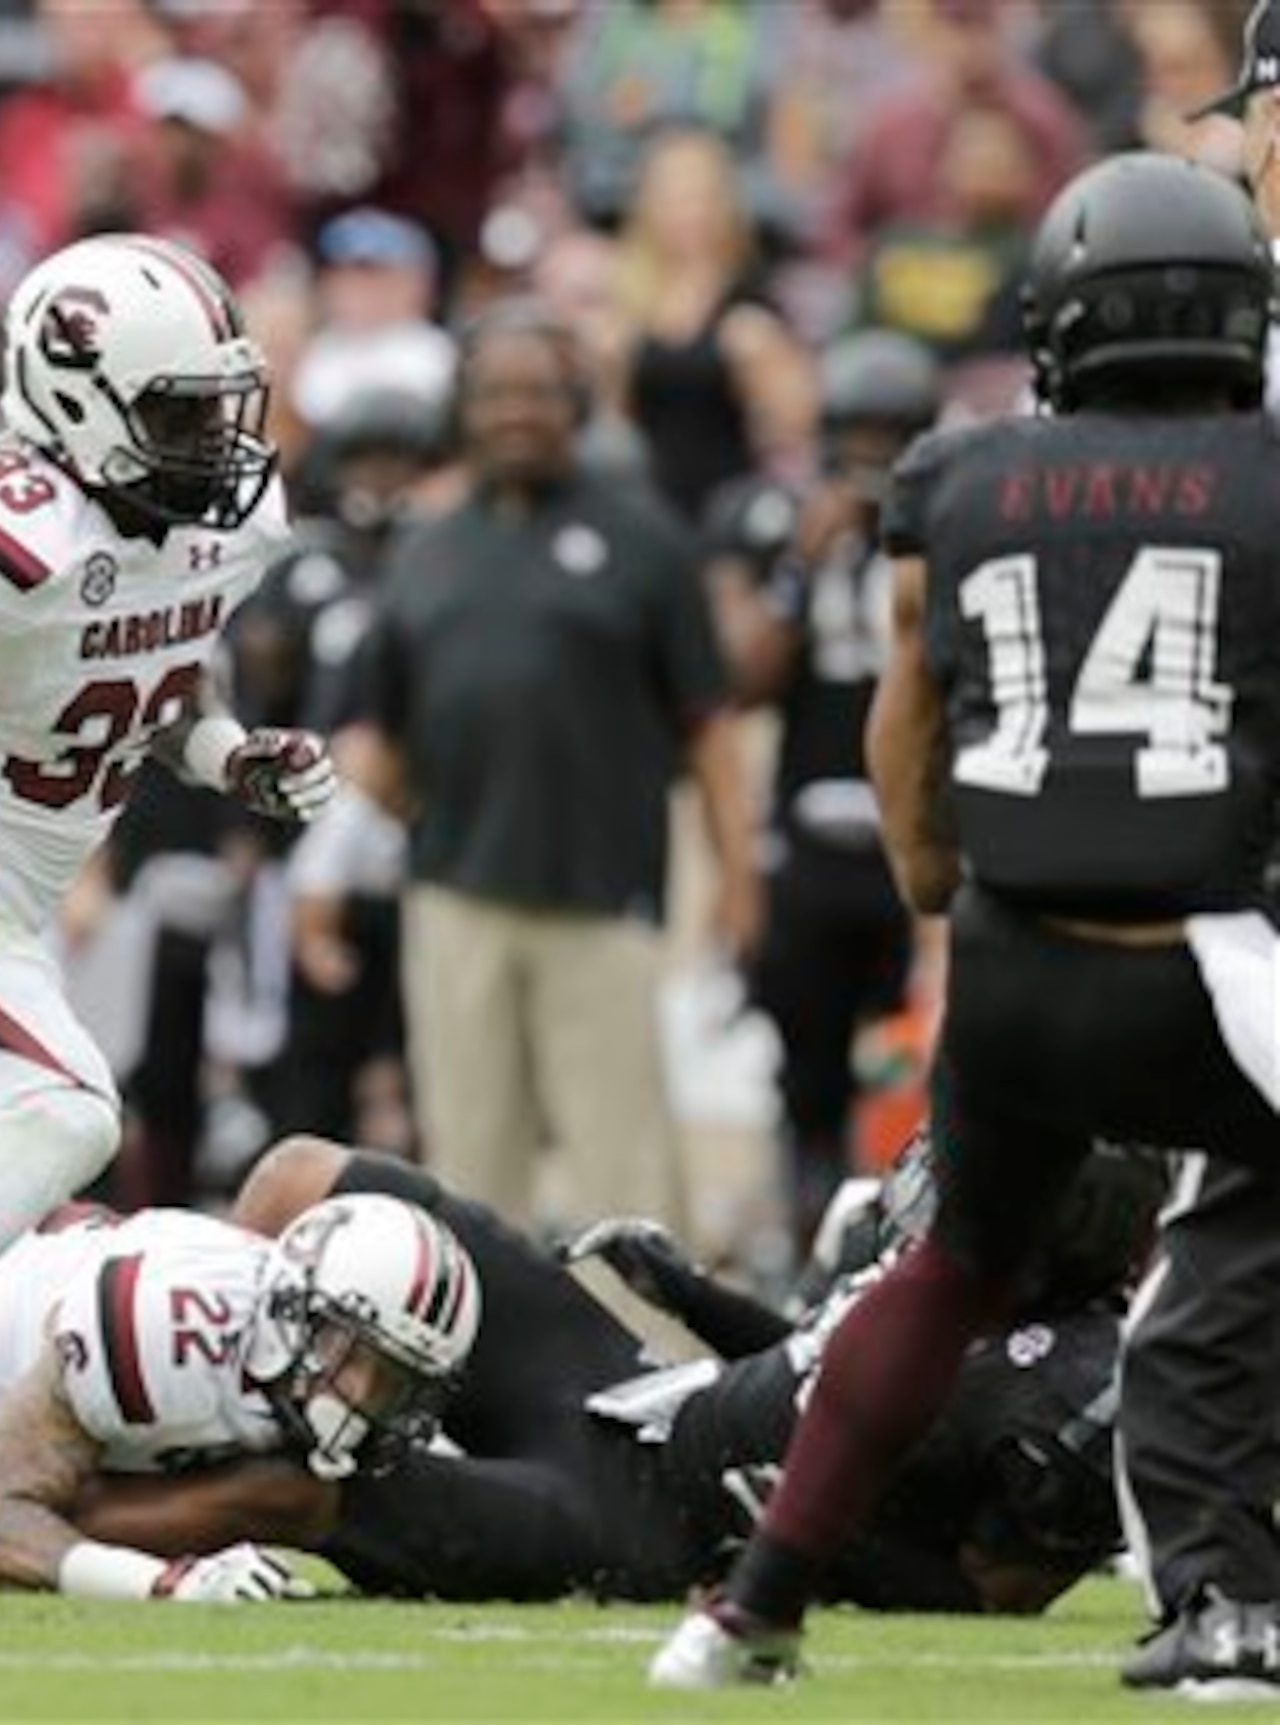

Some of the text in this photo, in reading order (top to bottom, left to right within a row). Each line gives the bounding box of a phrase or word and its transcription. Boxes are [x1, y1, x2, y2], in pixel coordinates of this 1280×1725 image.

[1001, 466, 1213, 521] EVANS
[81, 594, 223, 660] CAROLINA
[952, 546, 1235, 799] 14
[169, 1287, 238, 1367] 22
